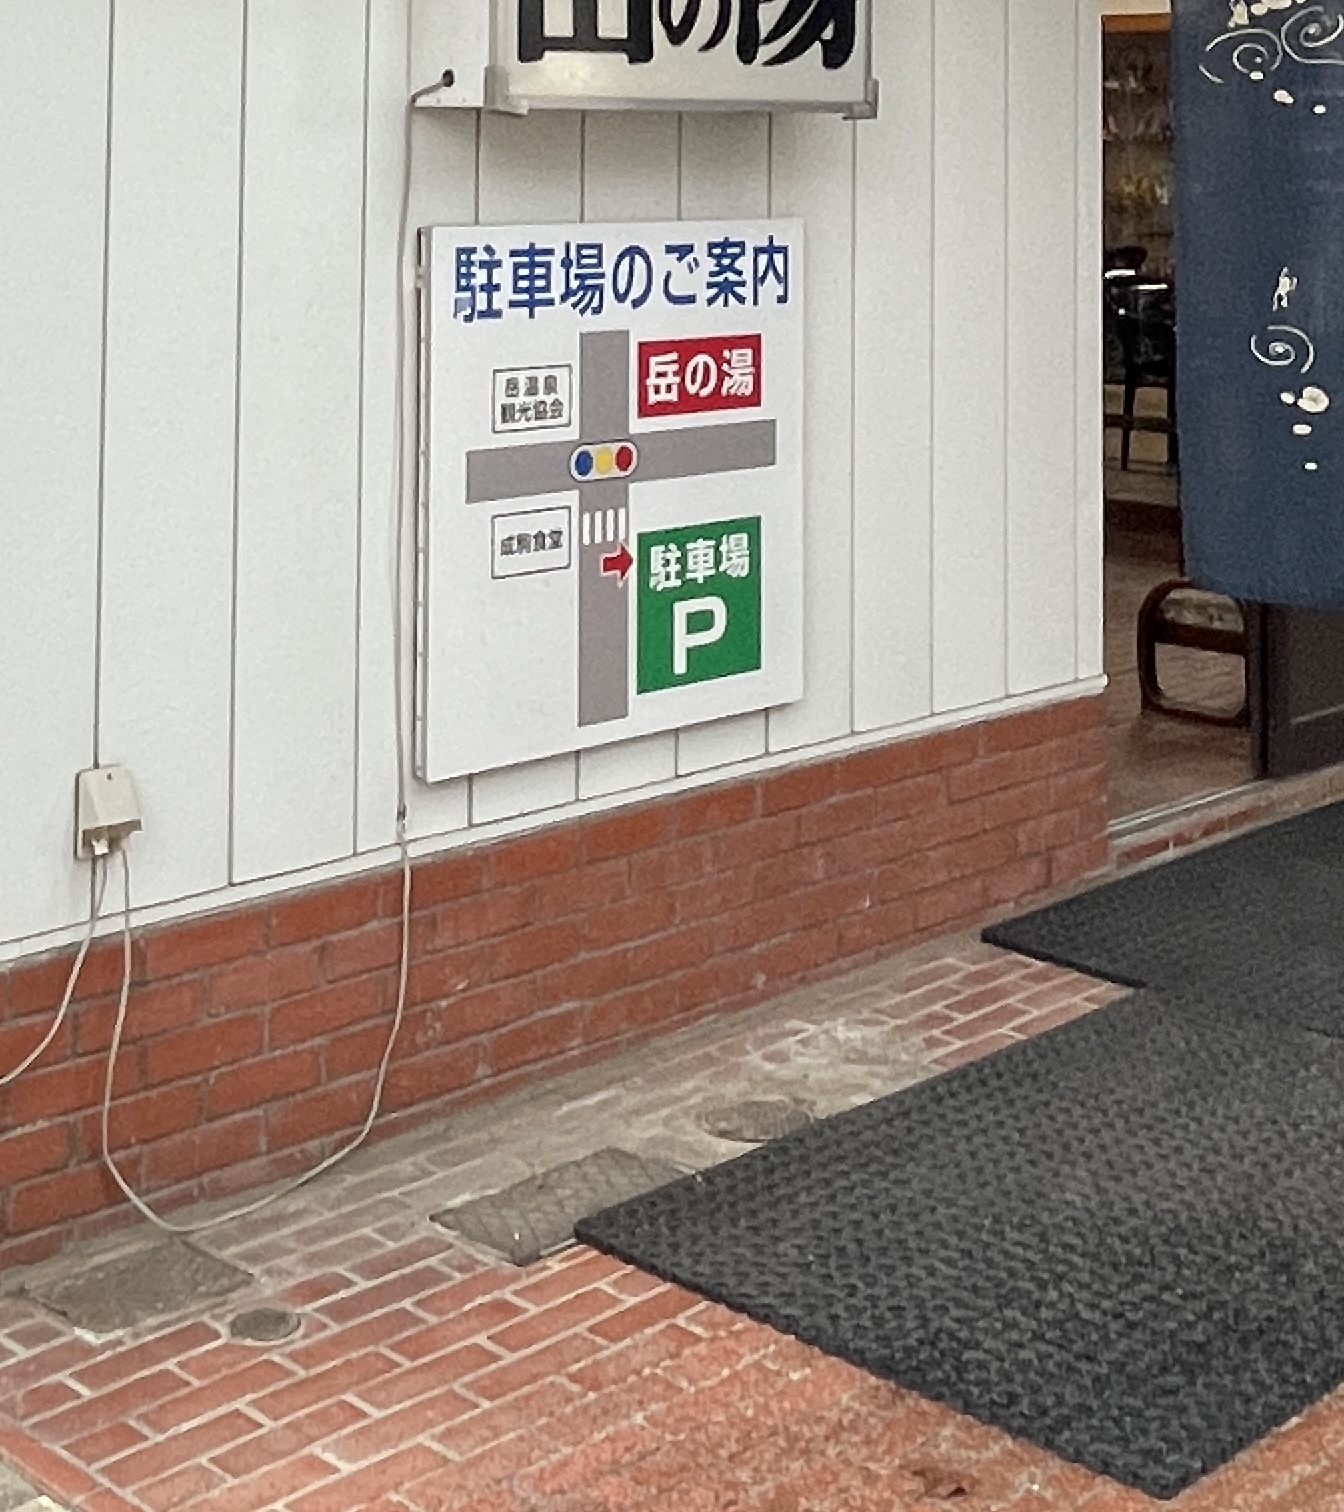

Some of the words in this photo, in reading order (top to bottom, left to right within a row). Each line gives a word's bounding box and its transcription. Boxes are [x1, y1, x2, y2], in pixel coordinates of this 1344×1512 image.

[453, 235, 789, 323] 駐車場のご案内
[645, 348, 756, 403] 岳の湯
[649, 533, 751, 591] 駐車場
[672, 595, 728, 675] P
